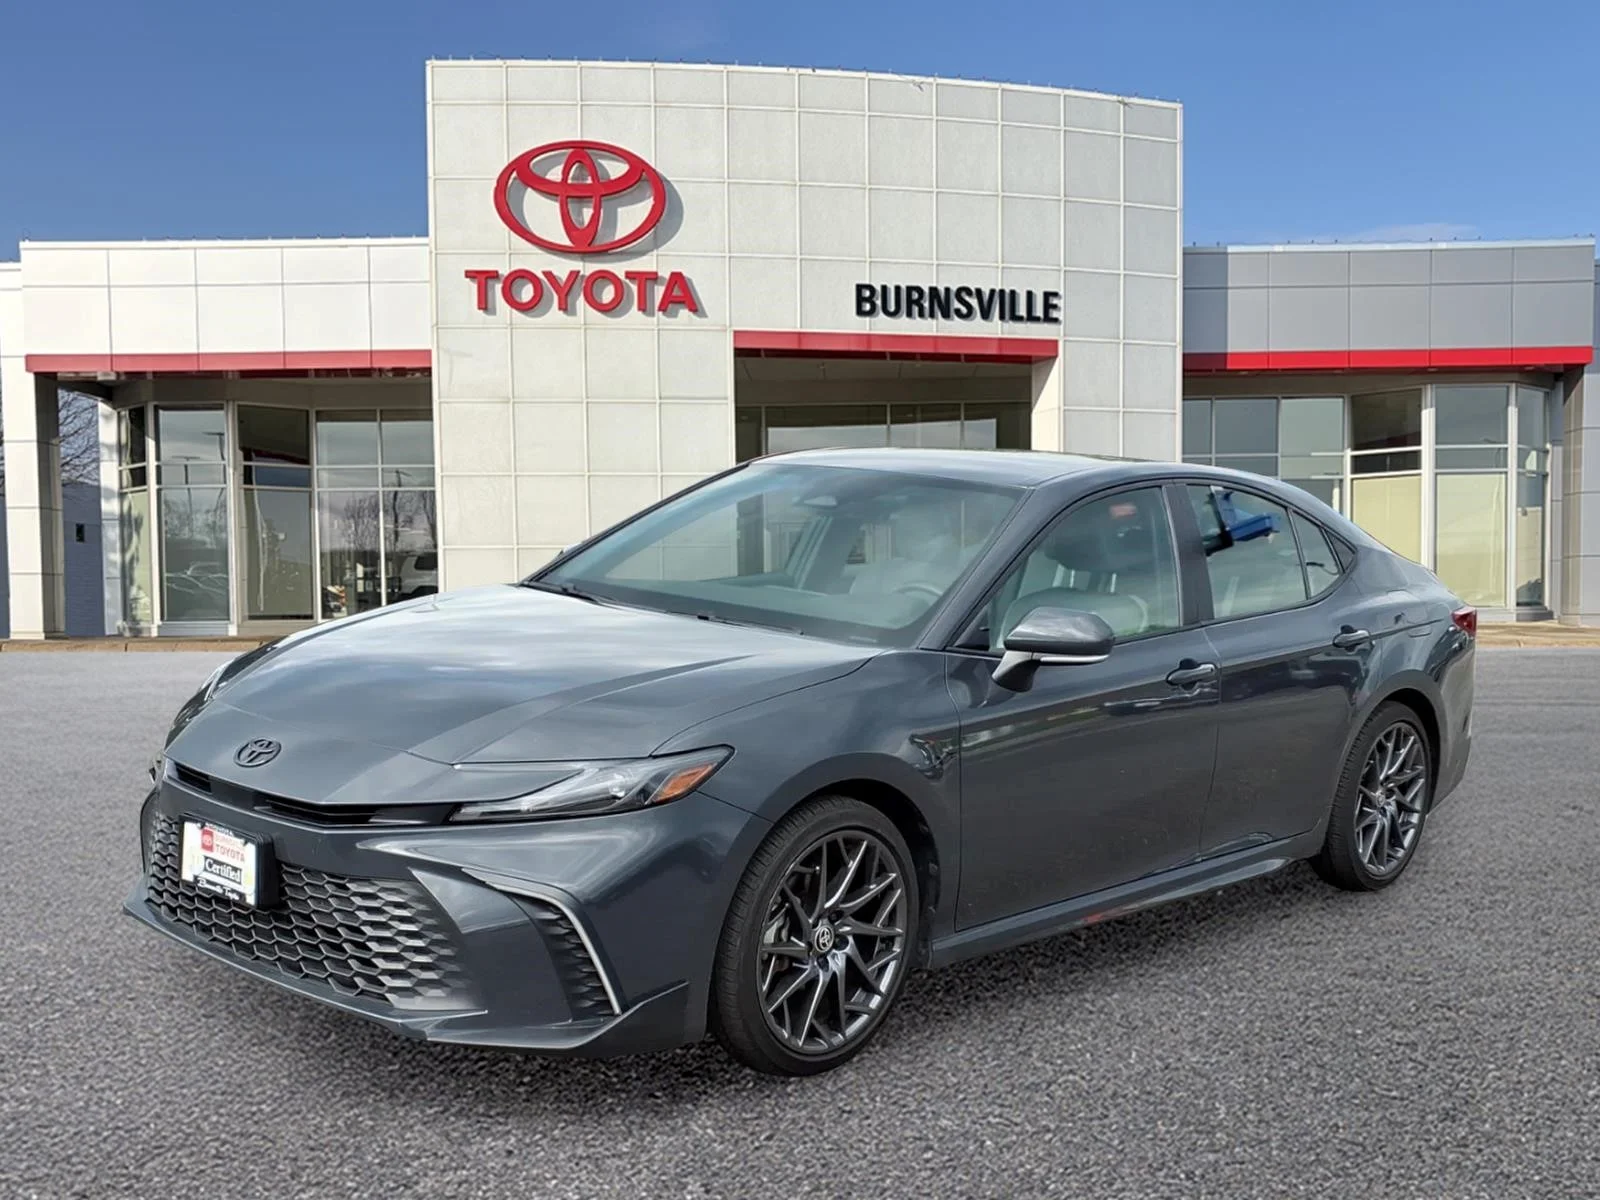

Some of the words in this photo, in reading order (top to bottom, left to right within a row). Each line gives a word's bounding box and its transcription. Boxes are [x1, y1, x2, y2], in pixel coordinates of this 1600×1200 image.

[464, 269, 698, 313] TOYOTA
[855, 283, 1061, 324] BURNSVILLE
[215, 844, 245, 862] TOYOTA
[205, 859, 241, 883] Certified
